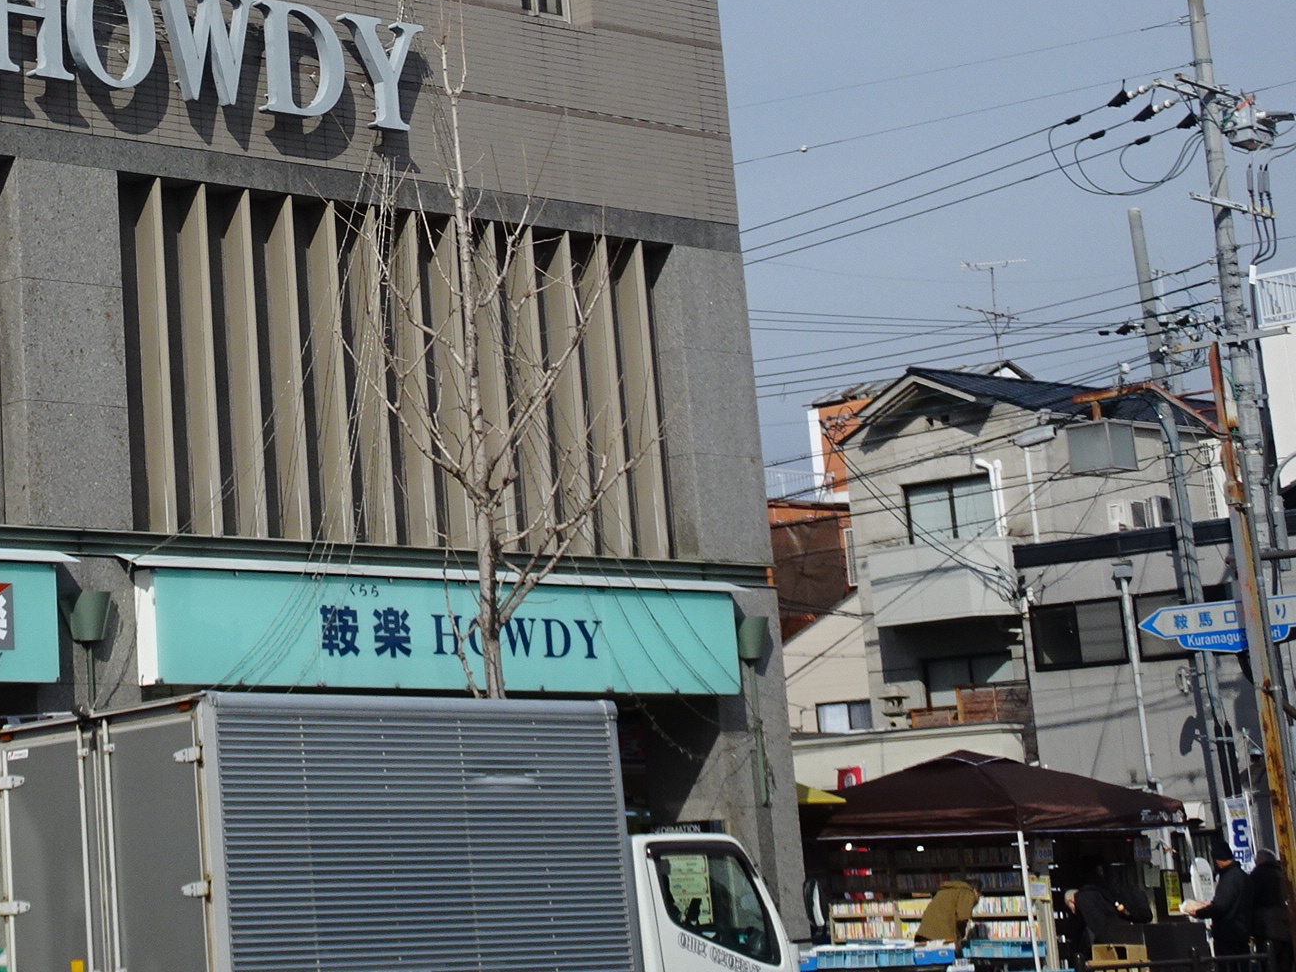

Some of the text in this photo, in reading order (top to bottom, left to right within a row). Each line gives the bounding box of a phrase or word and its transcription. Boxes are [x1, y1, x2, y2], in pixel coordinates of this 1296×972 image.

[349, 583, 380, 598] くらら
[1173, 603, 1287, 630] 鞍馬口り
[319, 604, 412, 659] 鞍楽
